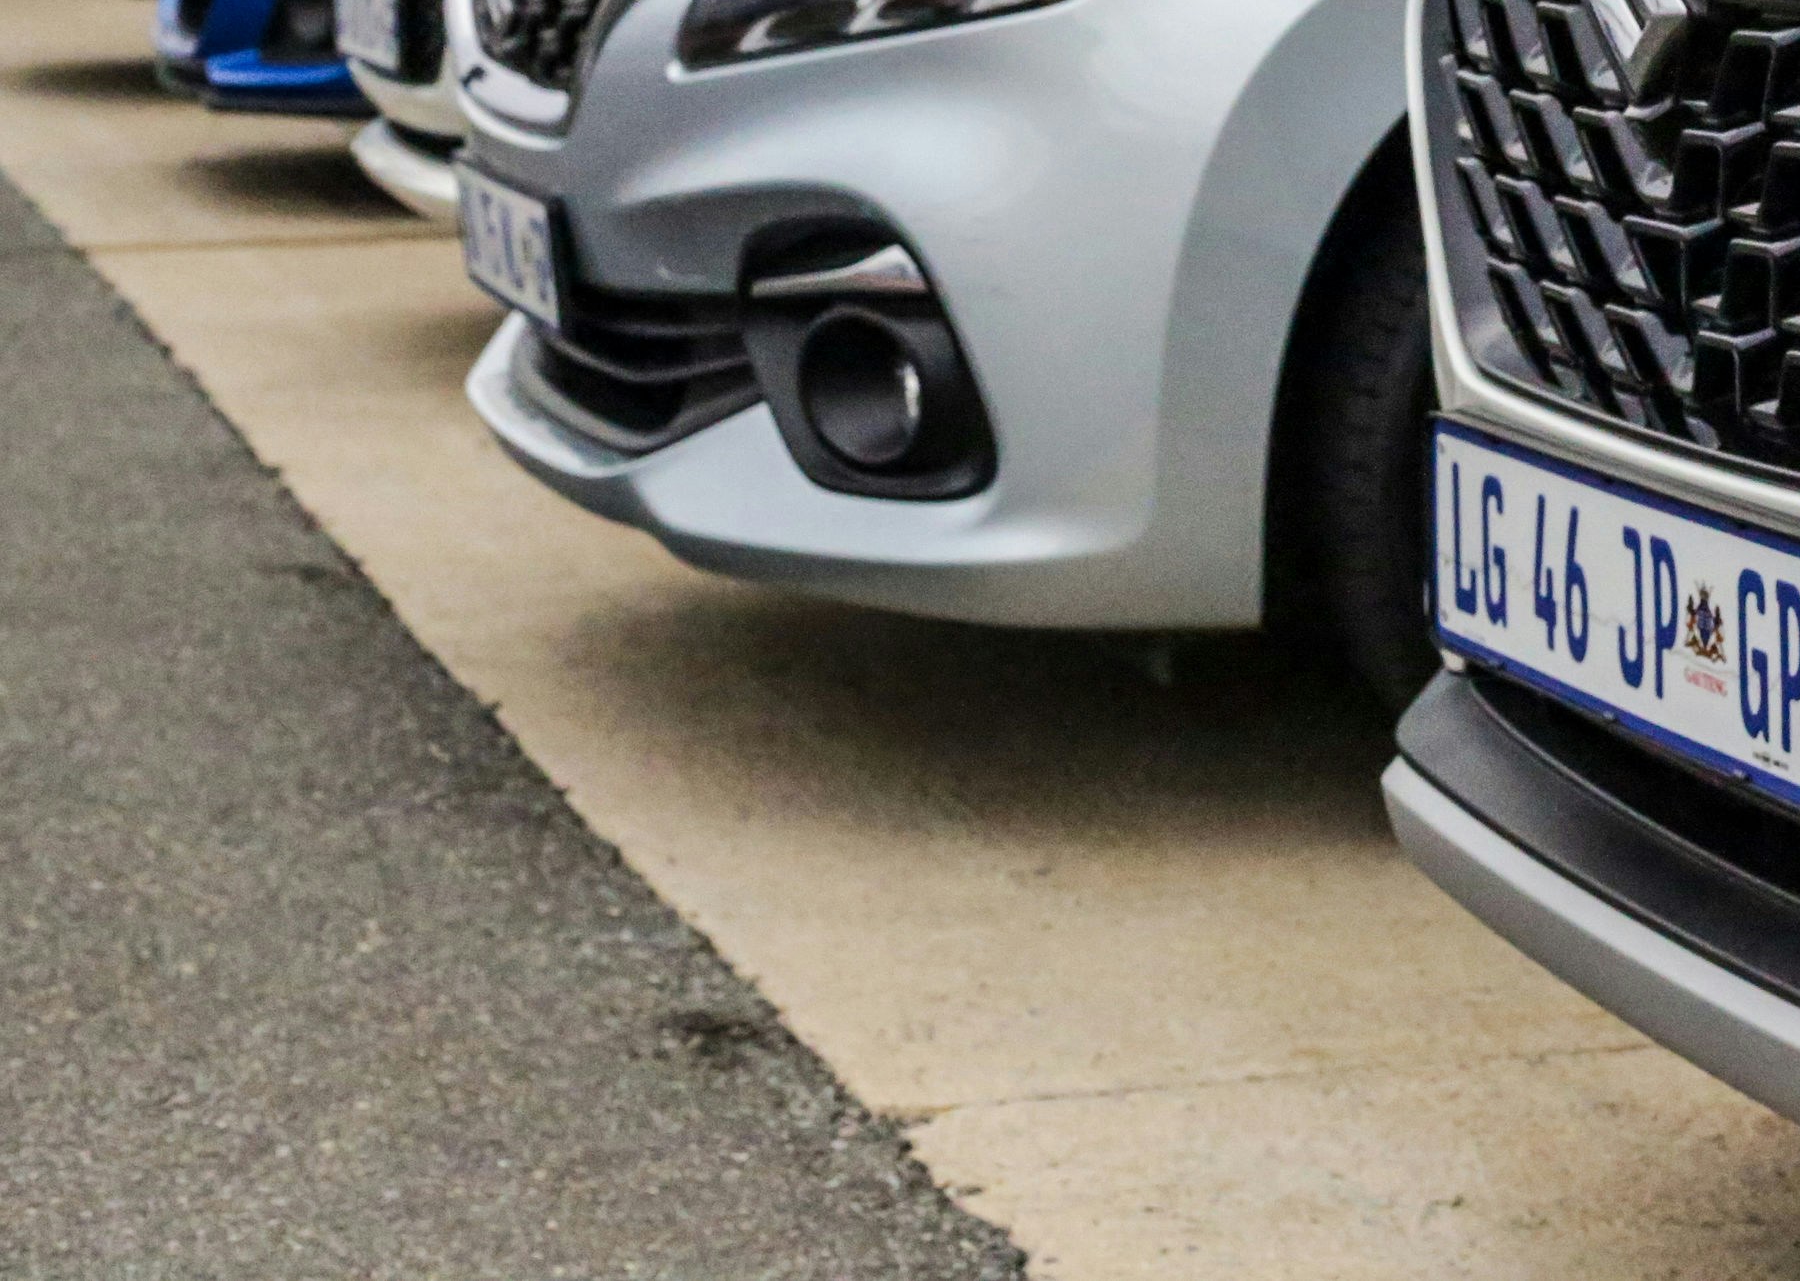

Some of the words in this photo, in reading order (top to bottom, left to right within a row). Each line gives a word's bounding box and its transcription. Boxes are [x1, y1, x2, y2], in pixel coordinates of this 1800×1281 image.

[1452, 462, 1507, 627] LG
[1534, 494, 1589, 663] 46
[1618, 526, 1679, 699] JP
